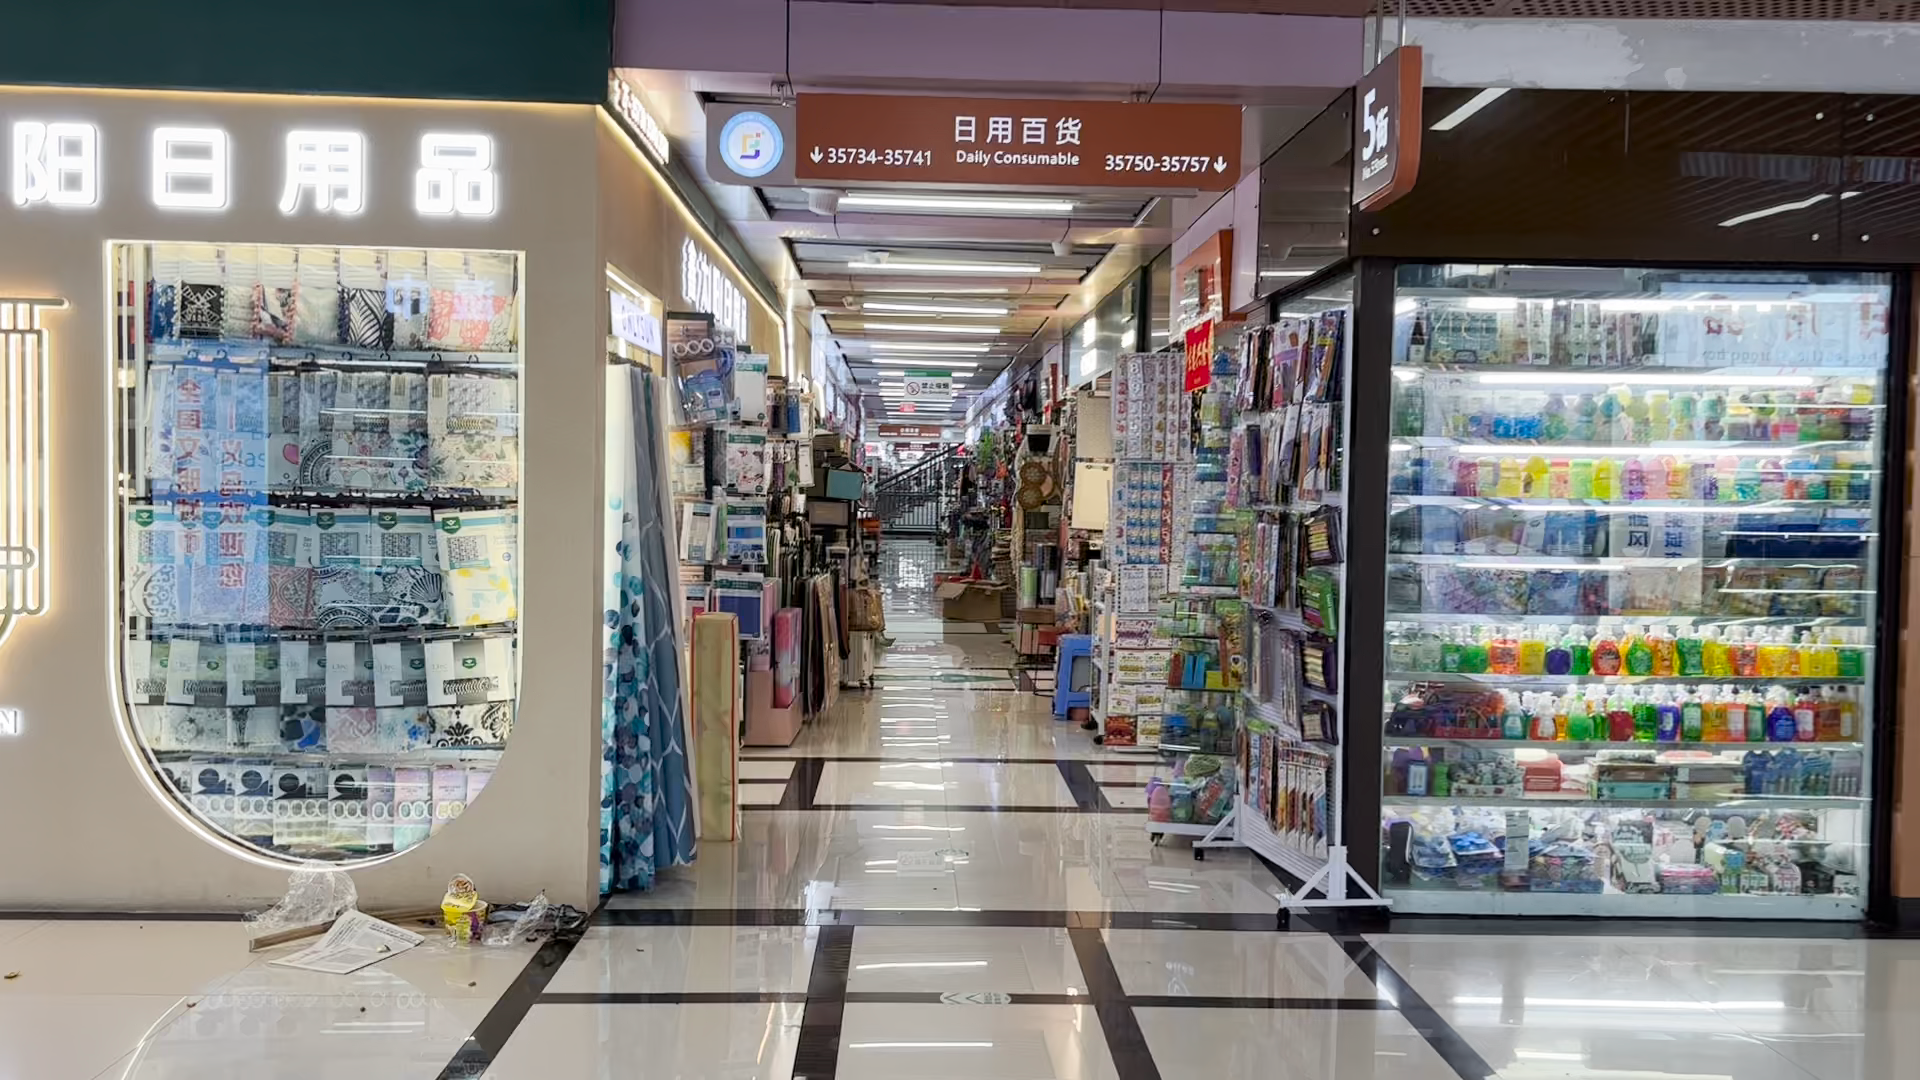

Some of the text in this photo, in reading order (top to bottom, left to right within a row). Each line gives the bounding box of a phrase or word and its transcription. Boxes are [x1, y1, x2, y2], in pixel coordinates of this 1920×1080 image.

[955, 115, 1082, 145] 日用百货
[827, 147, 932, 166] 35734-35741
[956, 150, 1080, 167] Daily Consumable
[1105, 154, 1210, 173] 35750-35757
[12, 120, 499, 217] 阳日用品
